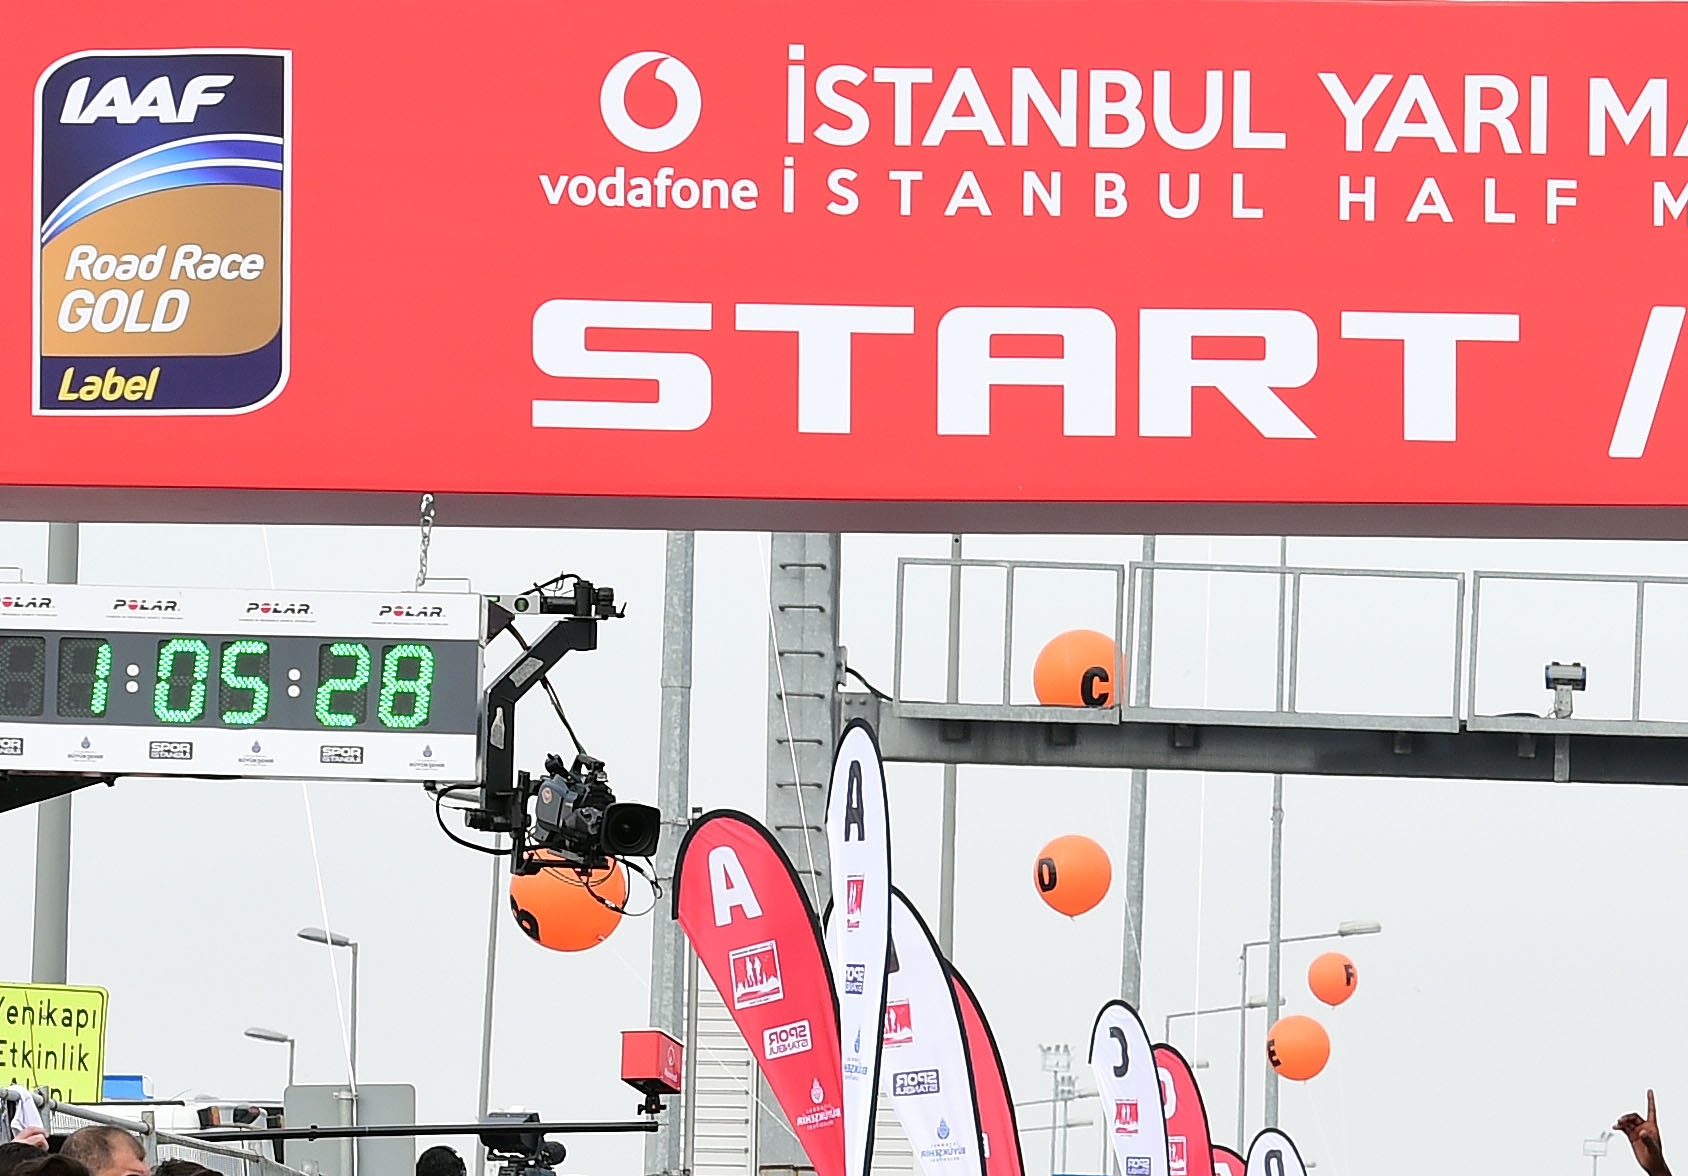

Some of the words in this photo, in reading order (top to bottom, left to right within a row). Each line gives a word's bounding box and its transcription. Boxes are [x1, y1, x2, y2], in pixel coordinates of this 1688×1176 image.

[60, 75, 234, 124] IAAF
[788, 44, 1287, 150] İSTANBUL
[1318, 72, 1549, 155] YARI
[539, 166, 759, 210] vodafone
[783, 156, 1264, 219] İSTANBUL
[1338, 175, 1578, 225] HALF
[65, 244, 162, 281] Road
[172, 244, 265, 282] Race
[57, 289, 190, 334] GOLD
[57, 366, 160, 403] Label
[531, 298, 1520, 442] START
[1607, 305, 1687, 459] /
[0, 596, 52, 609] OLAR
[113, 599, 178, 612] POLAR
[246, 602, 311, 615] POLAR
[378, 605, 443, 618] POLAR
[89, 637, 435, 729] 1:05:28
[1080, 666, 1110, 708] C
[1037, 857, 1058, 892] D
